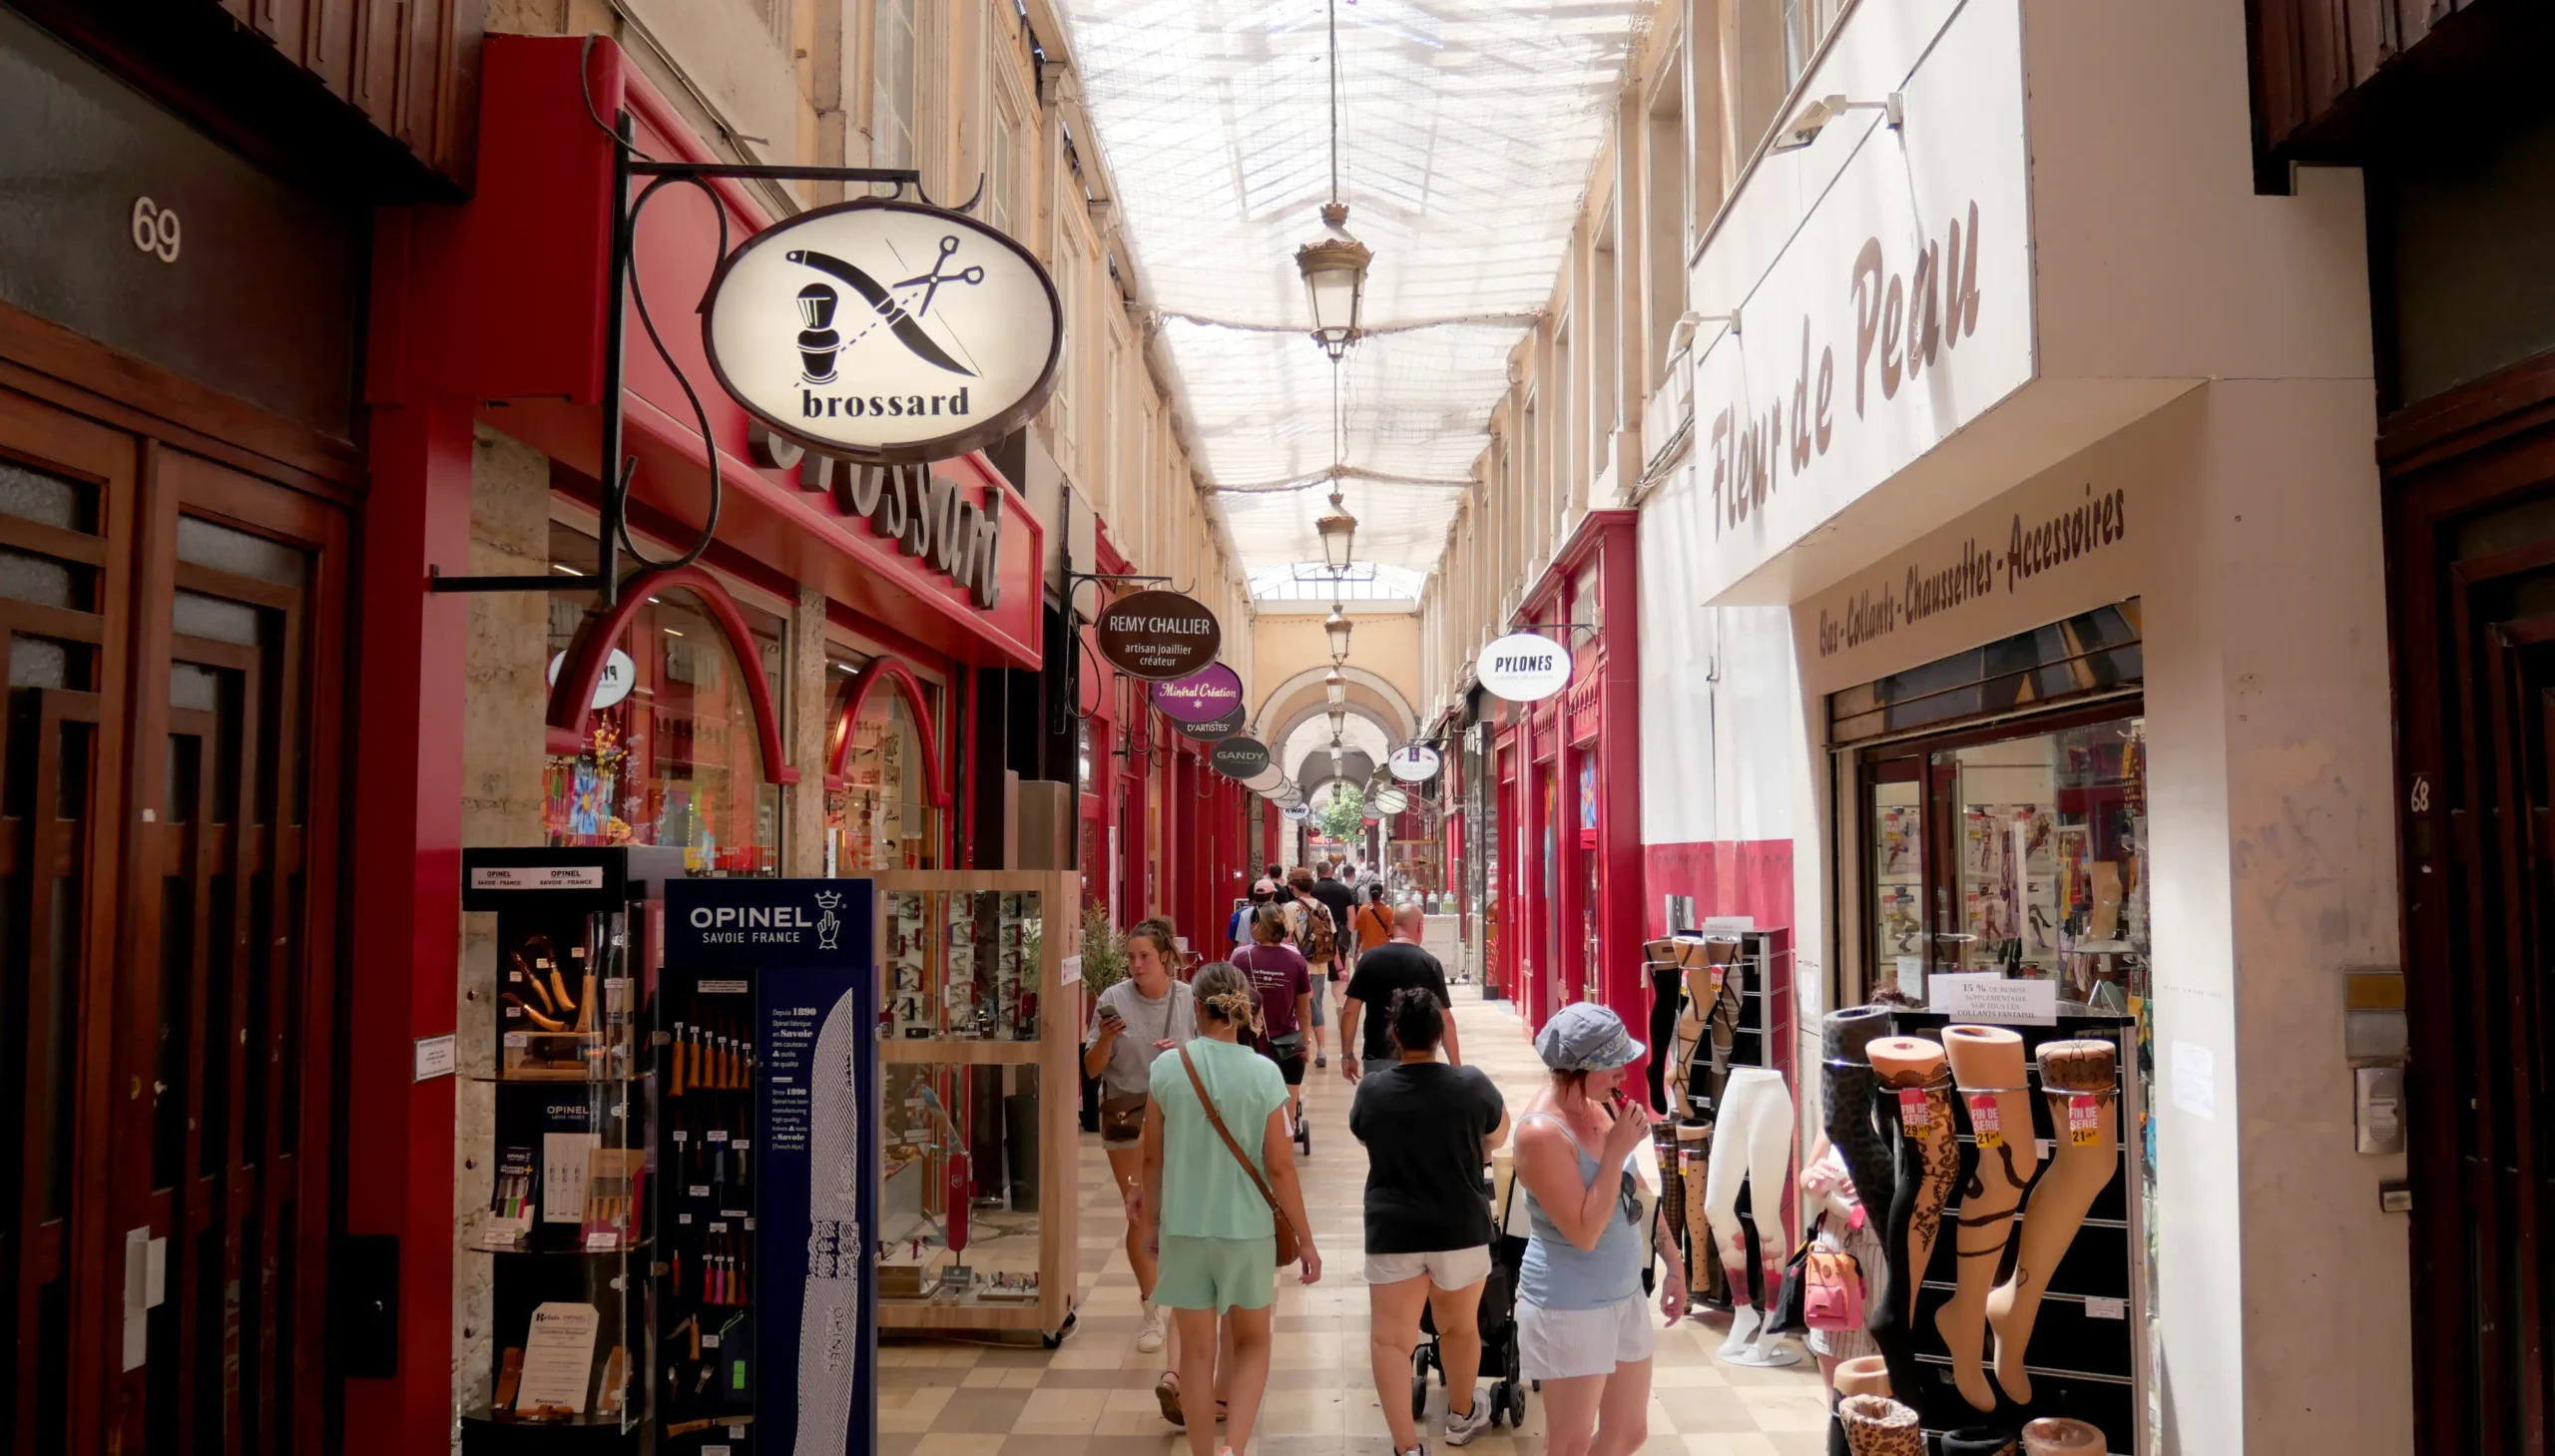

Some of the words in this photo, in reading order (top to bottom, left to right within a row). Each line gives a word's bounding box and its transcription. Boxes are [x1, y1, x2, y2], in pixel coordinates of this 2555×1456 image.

[131, 195, 182, 264] 69
[1711, 394, 1783, 545] Fleur
[1789, 312, 1834, 478] de
[1849, 199, 1981, 422] Peau
[801, 386, 970, 418] brossard
[1818, 608, 1838, 658] Bas
[1846, 582, 1894, 649] Collants
[1904, 537, 1992, 625] Chaussettes
[2007, 482, 2125, 596] Accessoires
[1109, 615, 1147, 633] REMY
[1148, 616, 1211, 636] CHALLIER
[1125, 644, 1157, 654] artisan
[1157, 644, 1192, 656] joaillier
[1139, 656, 1177, 667] créateur
[1495, 655, 1553, 673] PYLONES
[1159, 683, 1199, 699] Minéral
[1199, 684, 1237, 699] Création
[1217, 750, 1265, 761] GANDY
[2411, 775, 2430, 813] 68
[690, 906, 812, 928] OPINEL
[703, 932, 745, 943] SAVOIE
[753, 931, 800, 943] FRANCE
[1962, 983, 1974, 992] 15
[792, 1007, 816, 1016] 1890
[779, 1029, 813, 1038] Savoie
[546, 1105, 590, 1115] OPINEL
[1900, 1103, 1916, 1114] FIN
[1916, 1103, 1928, 1114] DE
[1971, 1108, 1986, 1119] FIN
[1987, 1108, 1999, 1119] DE
[2069, 1107, 2084, 1118] FIN
[2085, 1106, 2098, 1117] DE
[1902, 1114, 1929, 1125] SERIE
[1973, 1118, 2000, 1131] SERIE
[2069, 1117, 2098, 1130] SERIE
[829, 1306, 844, 1372] OPINEL
